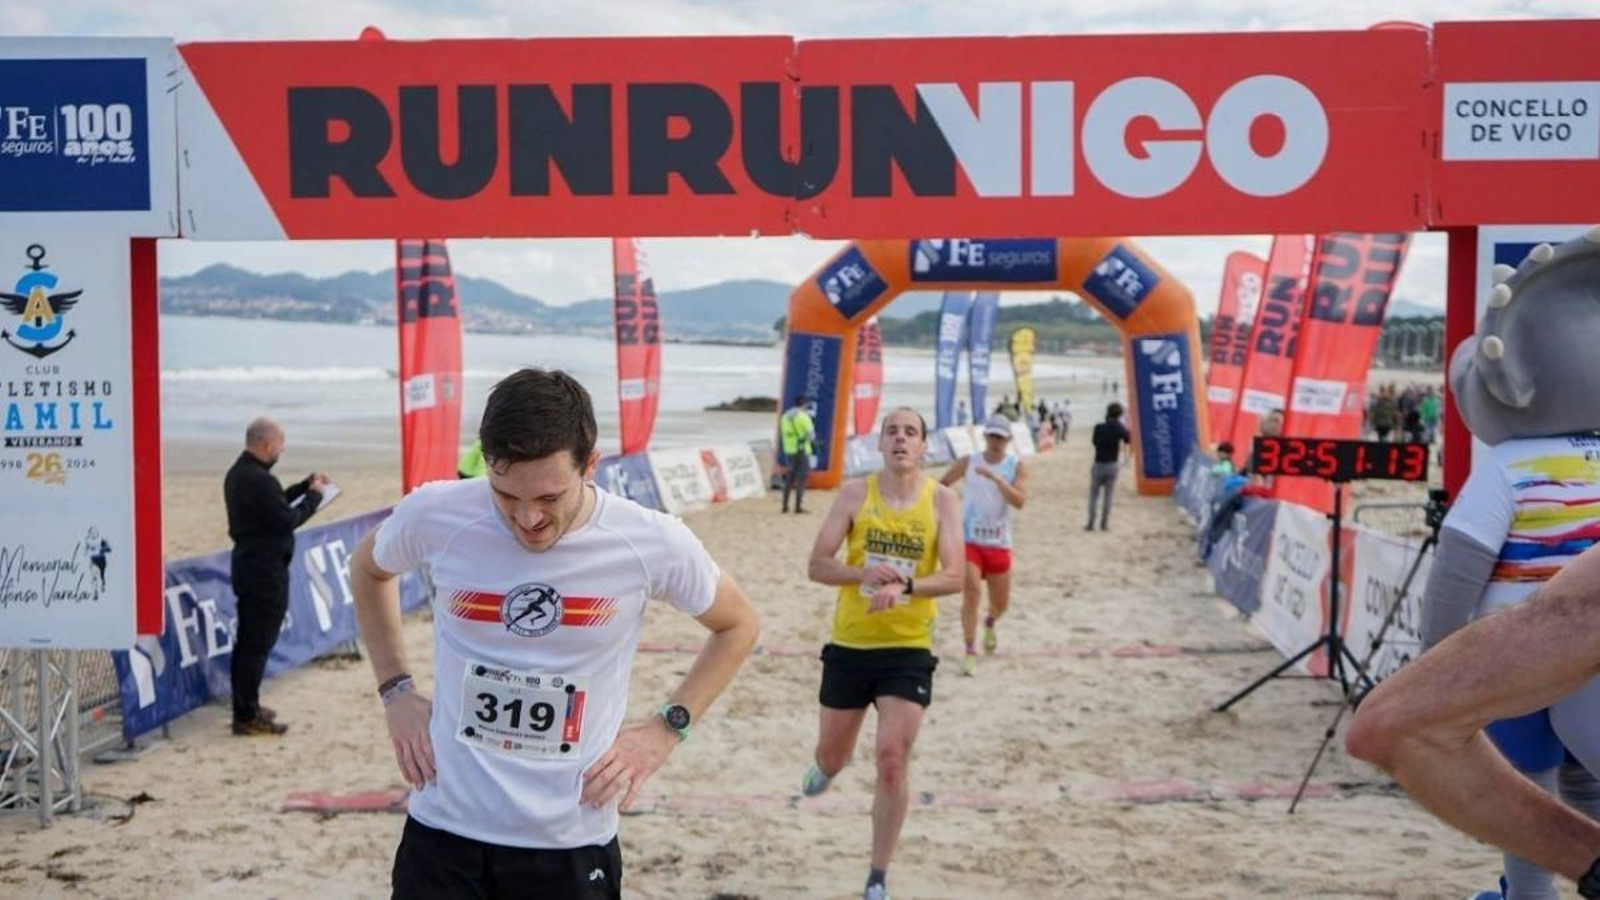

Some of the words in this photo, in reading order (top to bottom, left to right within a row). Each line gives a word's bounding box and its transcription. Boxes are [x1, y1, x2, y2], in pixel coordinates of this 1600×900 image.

[1456, 98, 1588, 118] CONCELLO
[60, 104, 132, 141] 100
[1470, 124, 1502, 142] DE
[1512, 123, 1572, 141] VIGO
[1, 141, 53, 157] seguros
[988, 251, 1051, 270] seguros
[1256, 274, 1297, 356] RUN
[26, 365, 60, 375] CLUB
[26, 452, 63, 479] 26
[66, 459, 96, 469] 2024
[475, 692, 556, 732] 319
